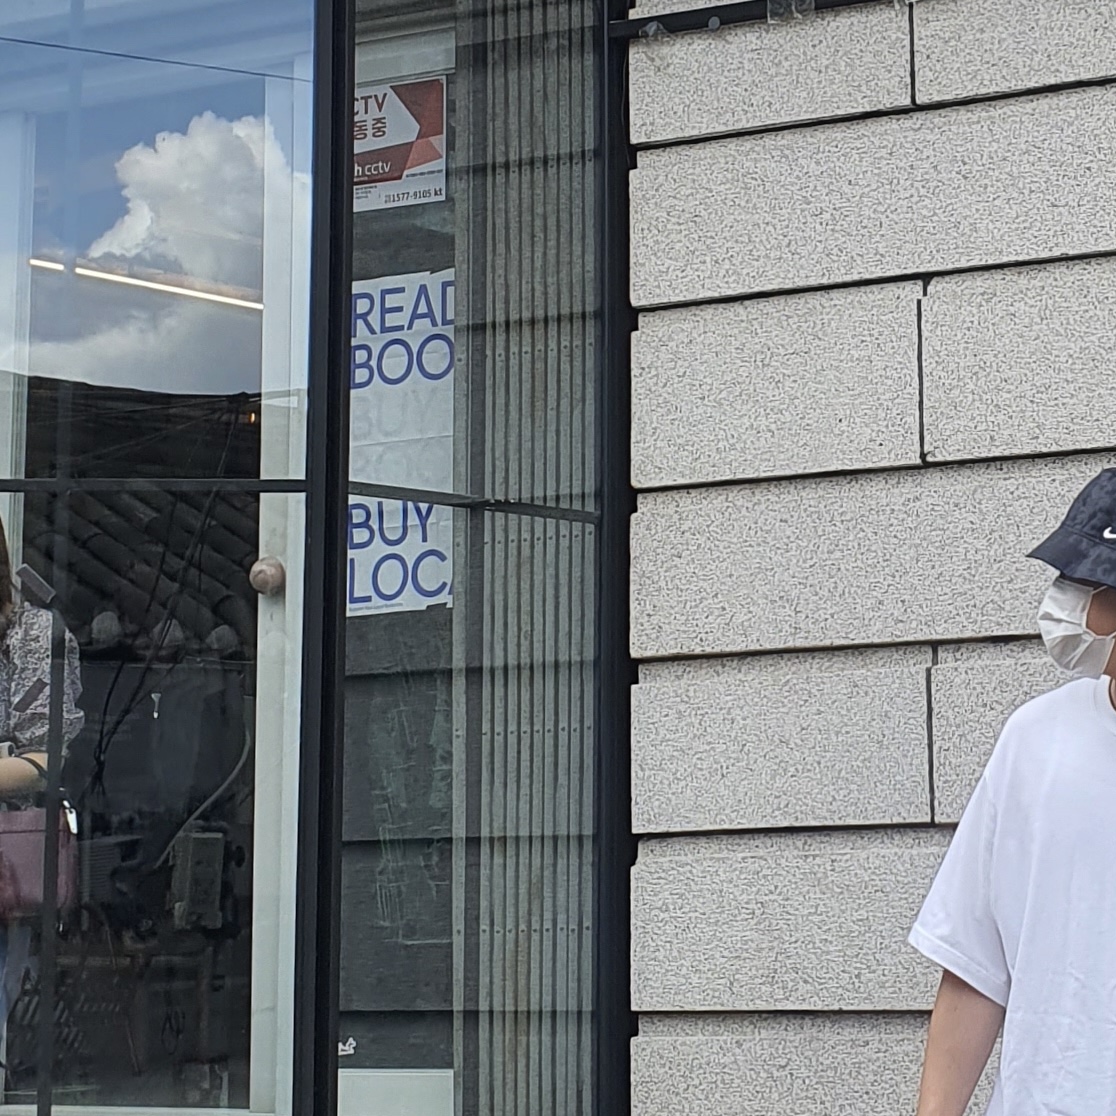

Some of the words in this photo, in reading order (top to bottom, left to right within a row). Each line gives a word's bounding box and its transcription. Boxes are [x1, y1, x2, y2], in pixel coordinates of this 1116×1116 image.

[364, 161, 391, 176] cctv
[348, 501, 434, 550] BUY
[348, 549, 454, 604] LOC
